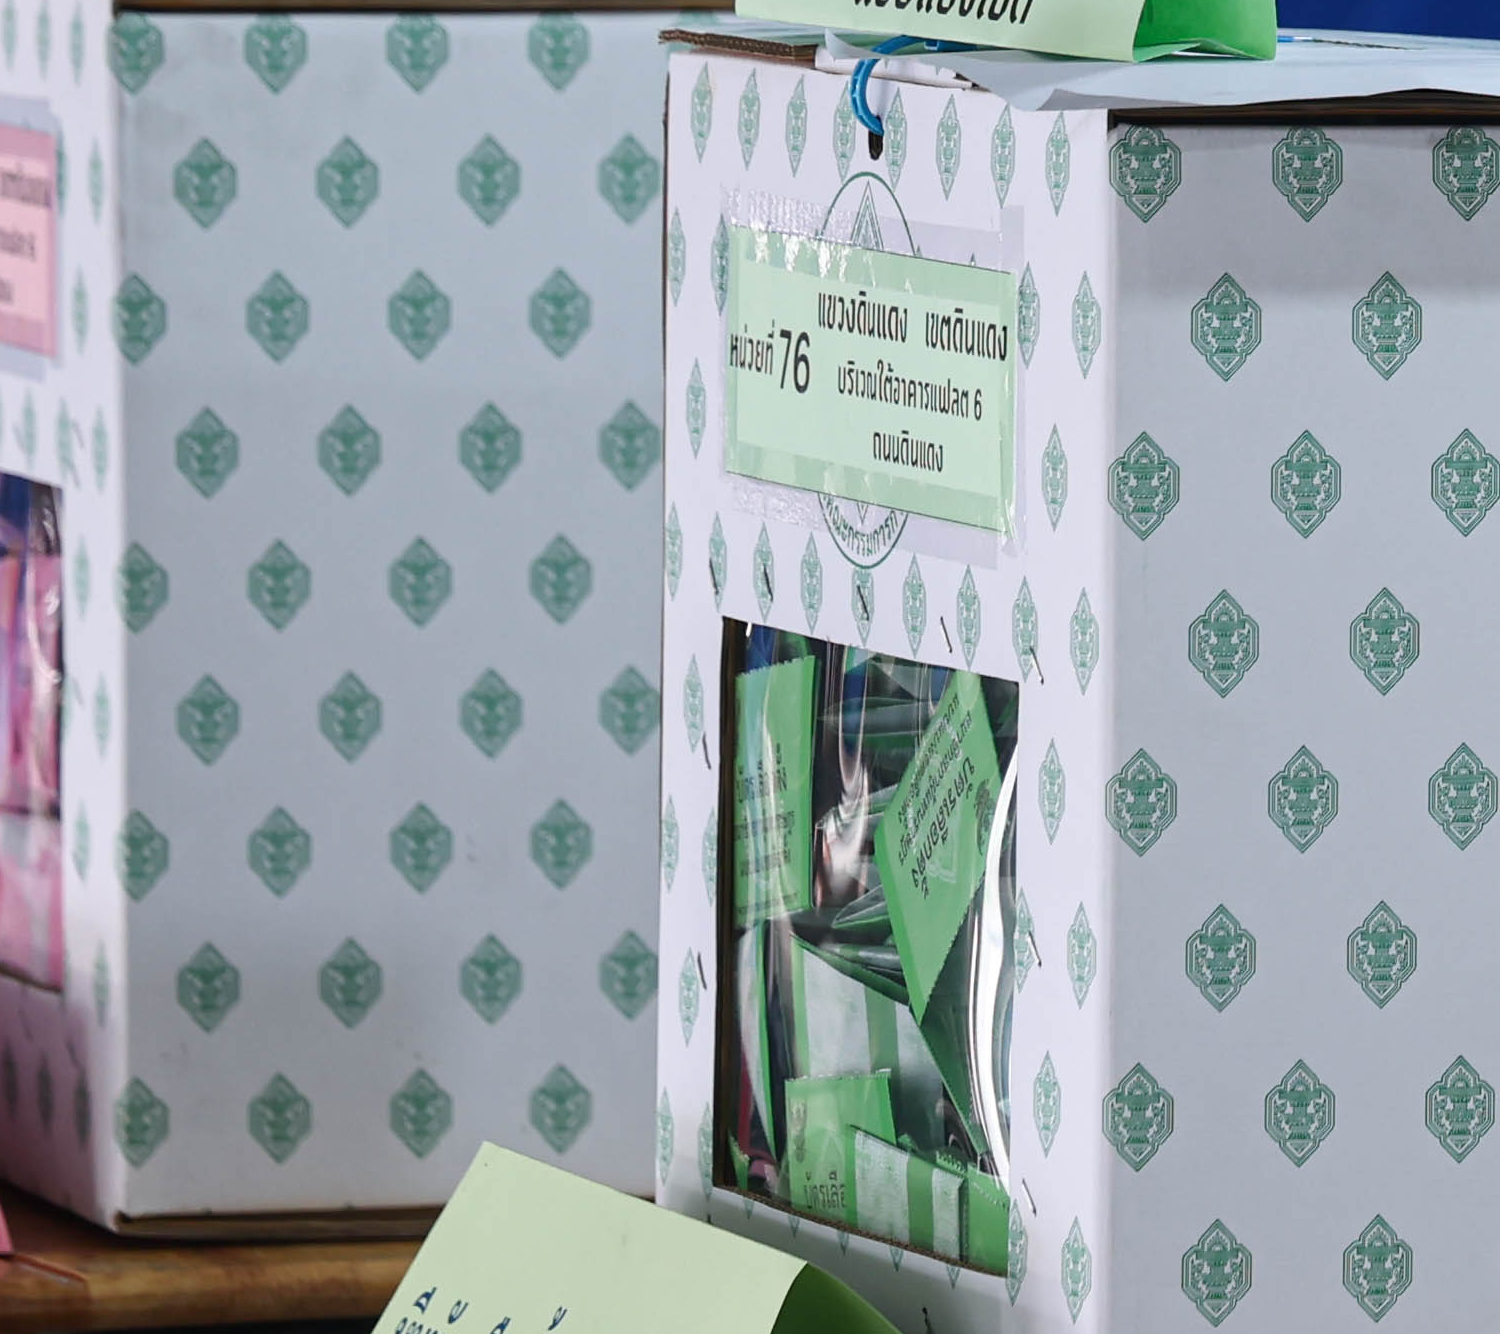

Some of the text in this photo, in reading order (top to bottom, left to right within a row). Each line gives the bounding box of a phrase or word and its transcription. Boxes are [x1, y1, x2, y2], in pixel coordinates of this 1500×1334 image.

[730, 318, 811, 394] หน่วยที่ 76
[817, 290, 1008, 362] แขวงดินแดง เขตดินแดง
[837, 357, 983, 421] บริเวณใต้อาคารแฟลต 6
[873, 430, 944, 473] ถนนดินแดง
[911, 755, 976, 900] บัตรเลือกตั้ง
